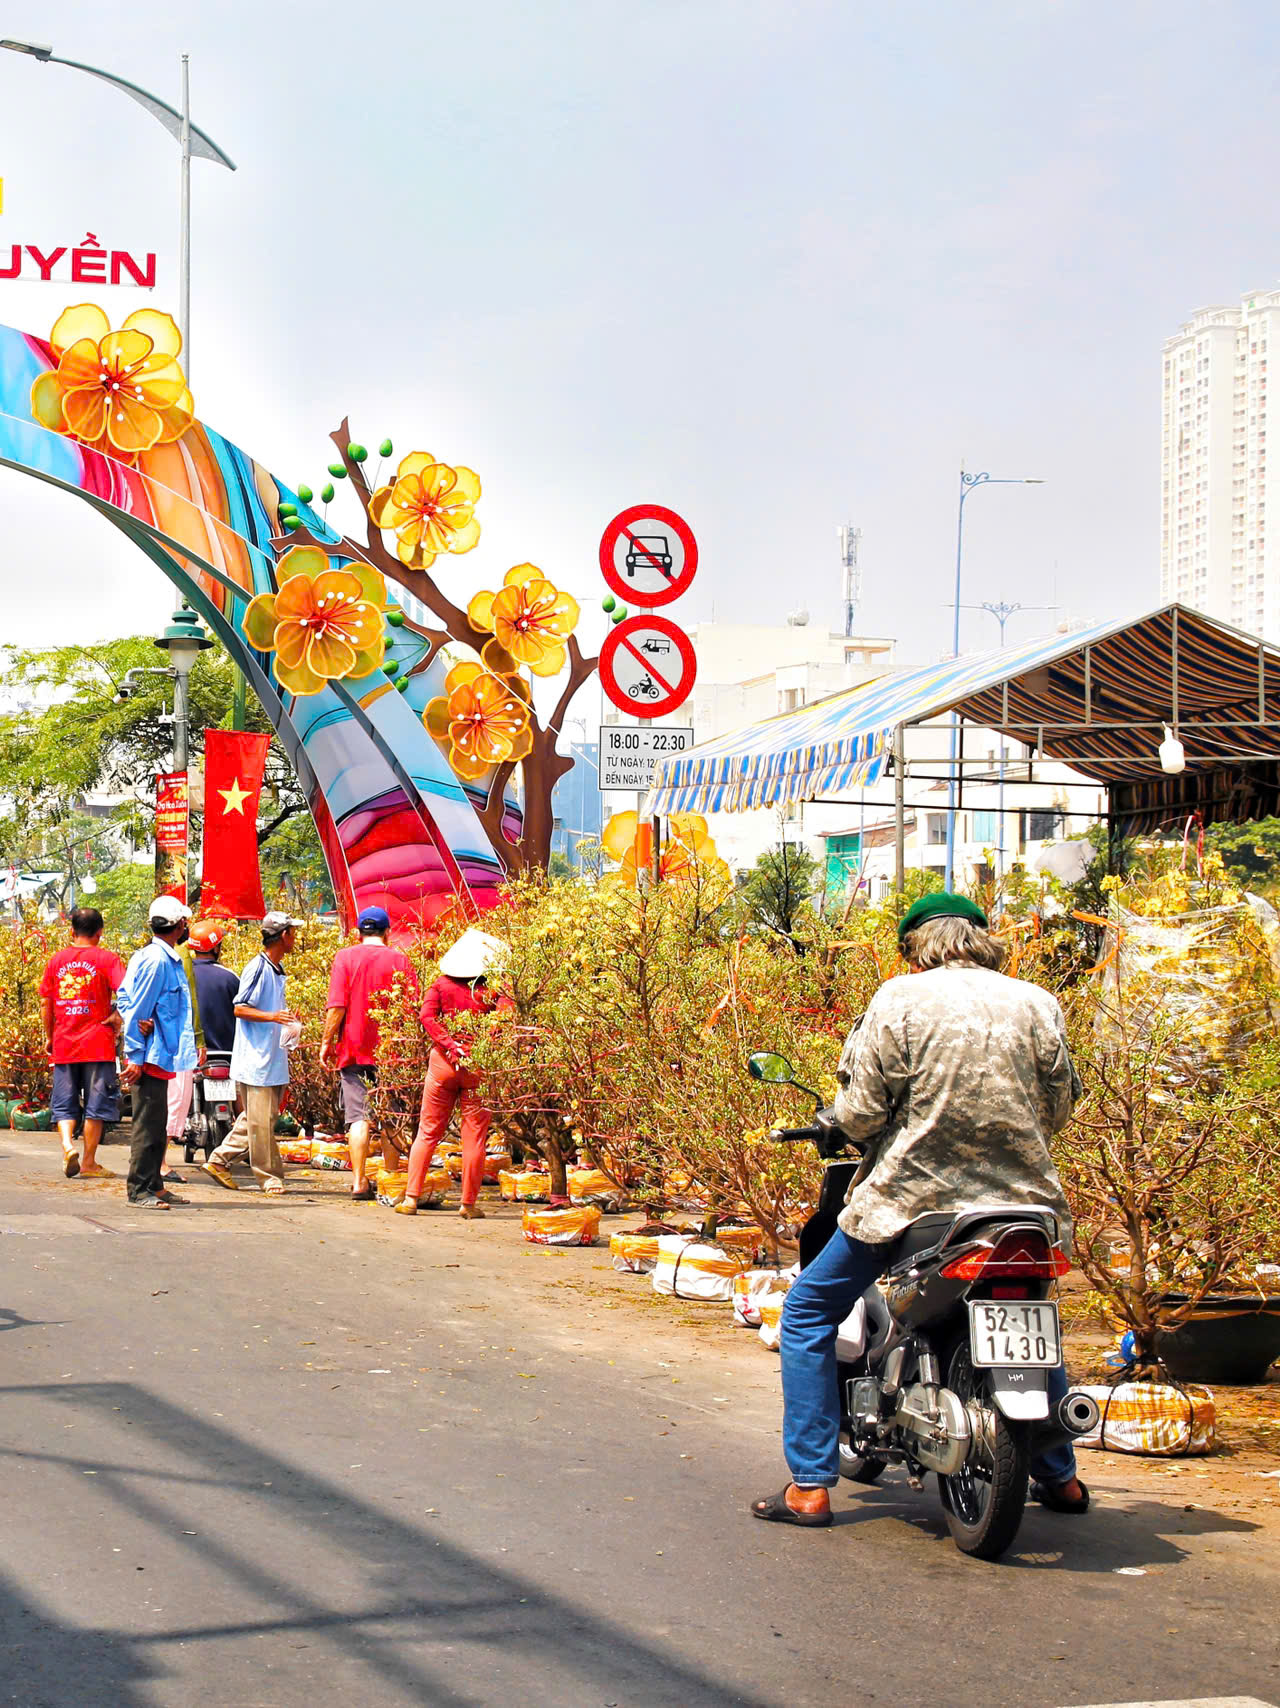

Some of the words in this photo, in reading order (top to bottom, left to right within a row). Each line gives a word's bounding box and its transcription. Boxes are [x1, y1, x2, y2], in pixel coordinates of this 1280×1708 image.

[609, 733, 640, 749] 18:00
[653, 735, 686, 751] 22:30
[606, 754, 619, 767] TỪ
[605, 771, 621, 784] ĐẾN
[65, 1006, 89, 1015] 2026
[984, 1307, 1042, 1333] 52-T1
[987, 1336, 1047, 1361] 1430
